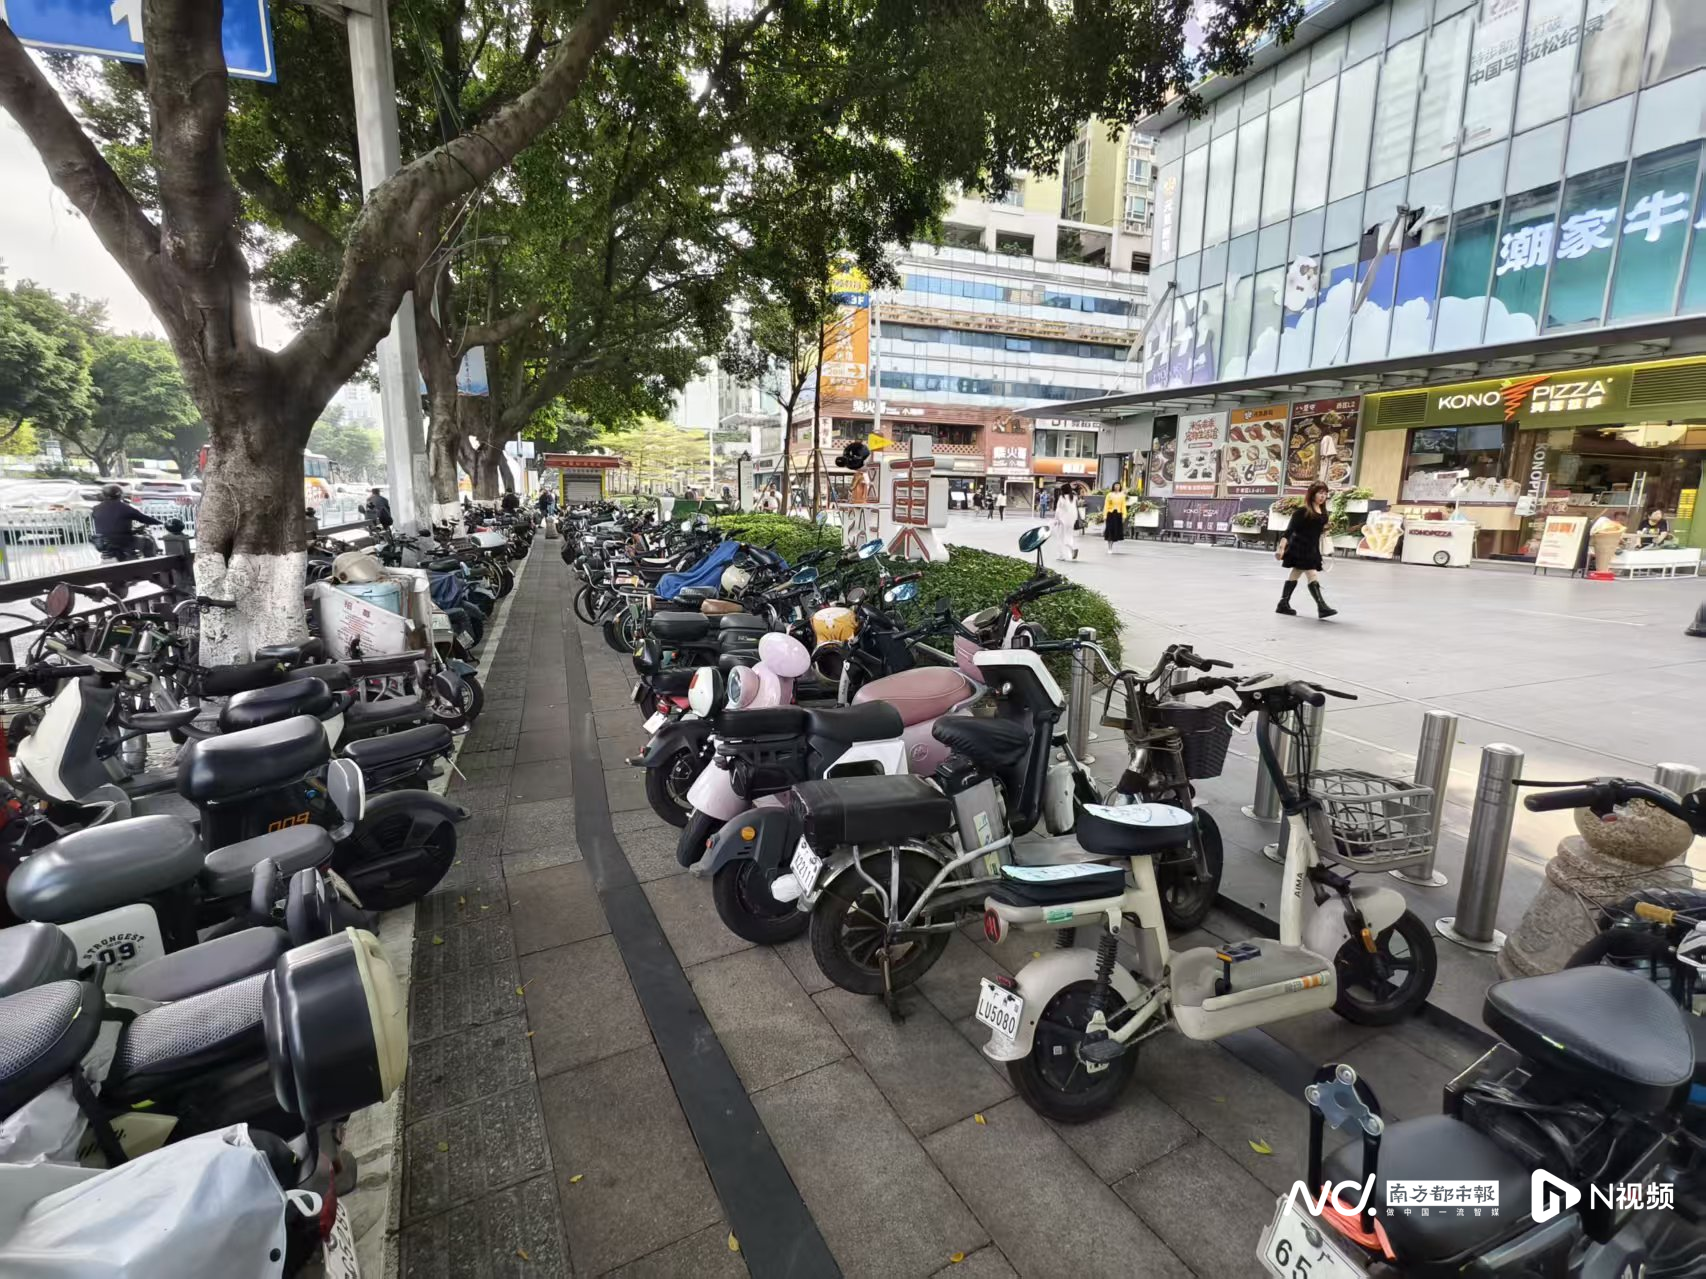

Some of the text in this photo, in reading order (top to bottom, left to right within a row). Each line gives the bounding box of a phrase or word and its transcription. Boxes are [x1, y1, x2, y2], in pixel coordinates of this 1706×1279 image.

[1496, 189, 1706, 276] 潮家牛
[1438, 380, 1606, 410] KONO PIZZA
[1294, 872, 1304, 898] AIMA
[83, 933, 145, 960] STRONGEST
[99, 942, 136, 966] 09
[978, 998, 1016, 1034] LU5080
